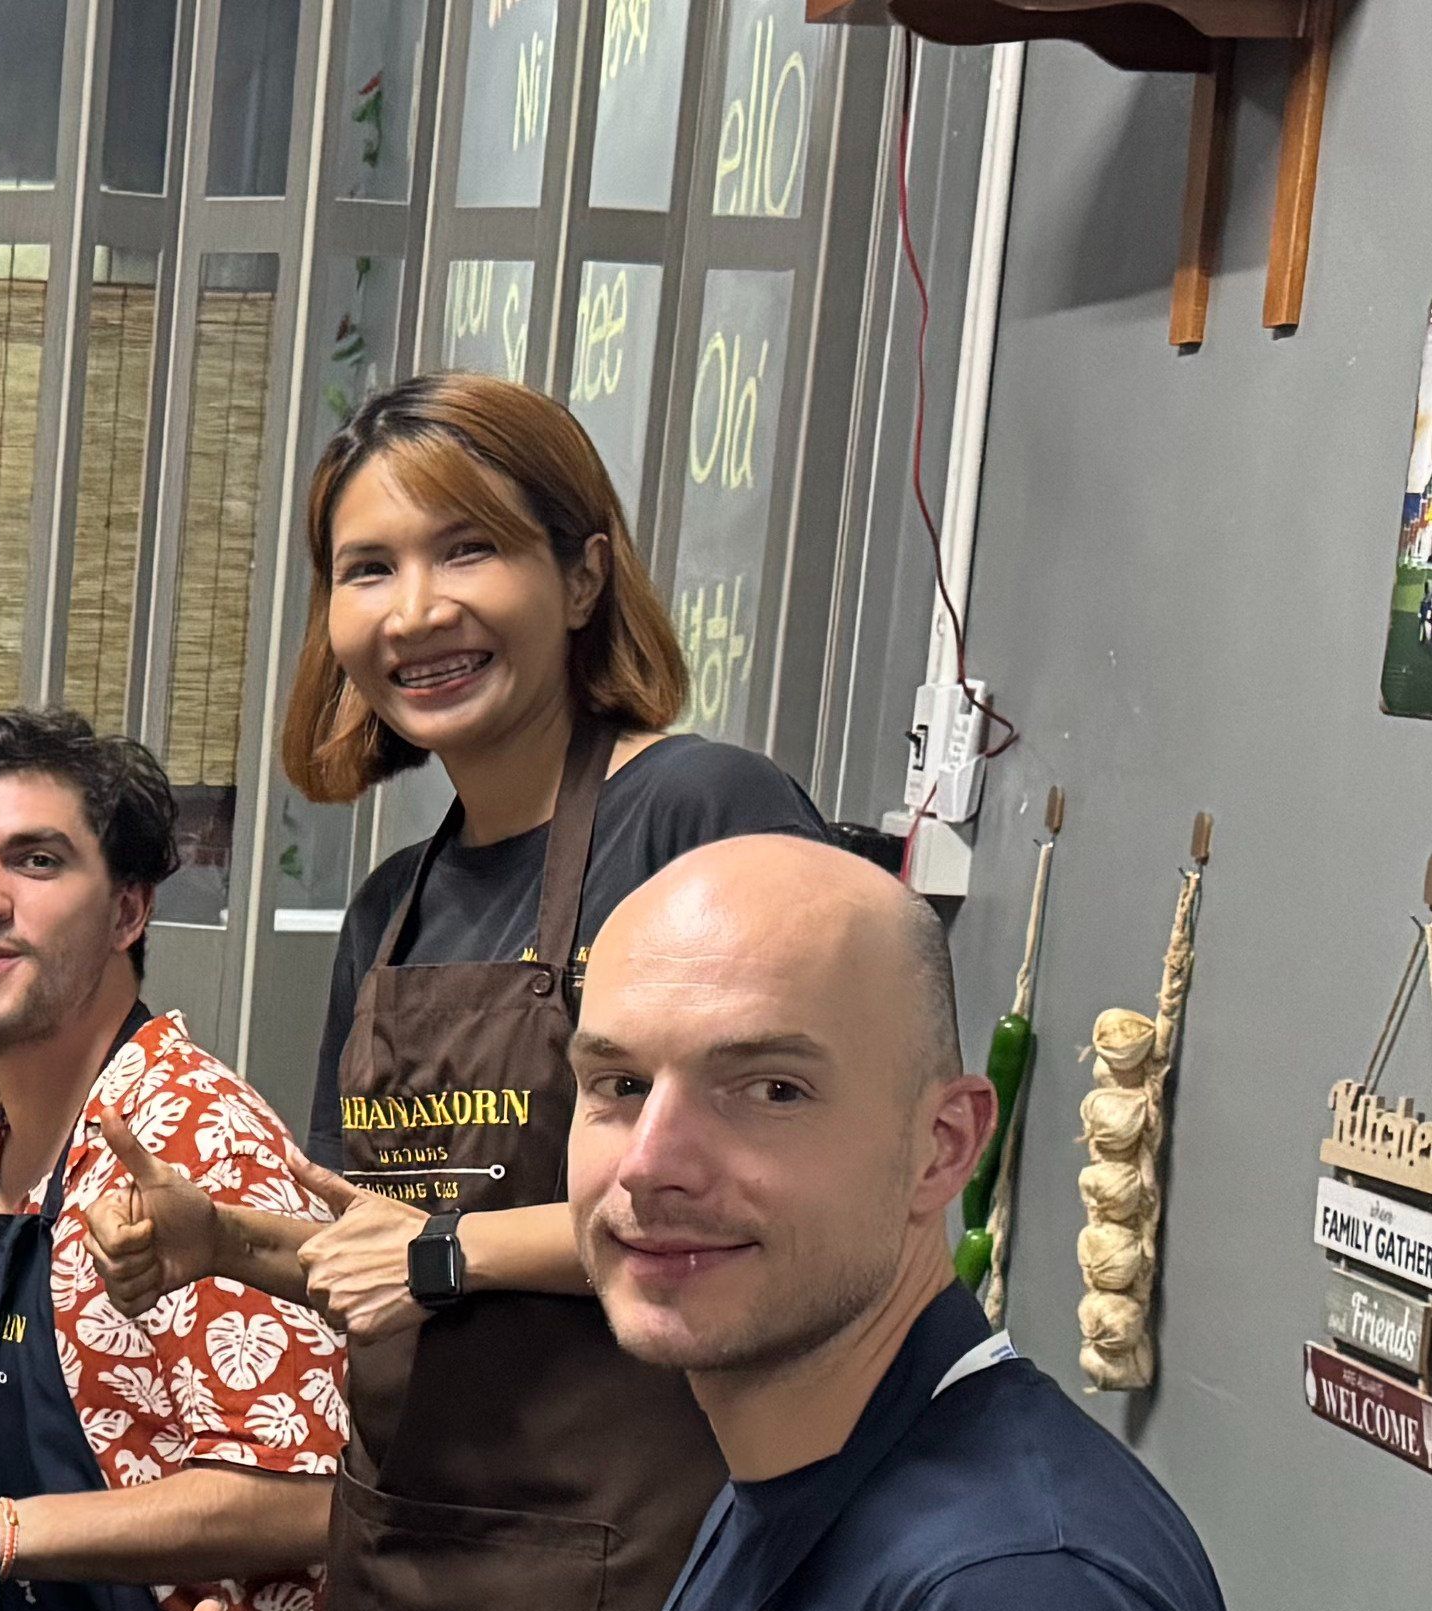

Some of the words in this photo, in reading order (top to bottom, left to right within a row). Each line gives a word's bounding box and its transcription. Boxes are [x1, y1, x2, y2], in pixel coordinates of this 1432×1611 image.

[712, 14, 806, 217] ello
[690, 330, 769, 490] Olá
[1322, 1206, 1373, 1254] FAMILY
[1352, 1291, 1417, 1362] Friends
[1321, 1377, 1421, 1457] WELCOME
